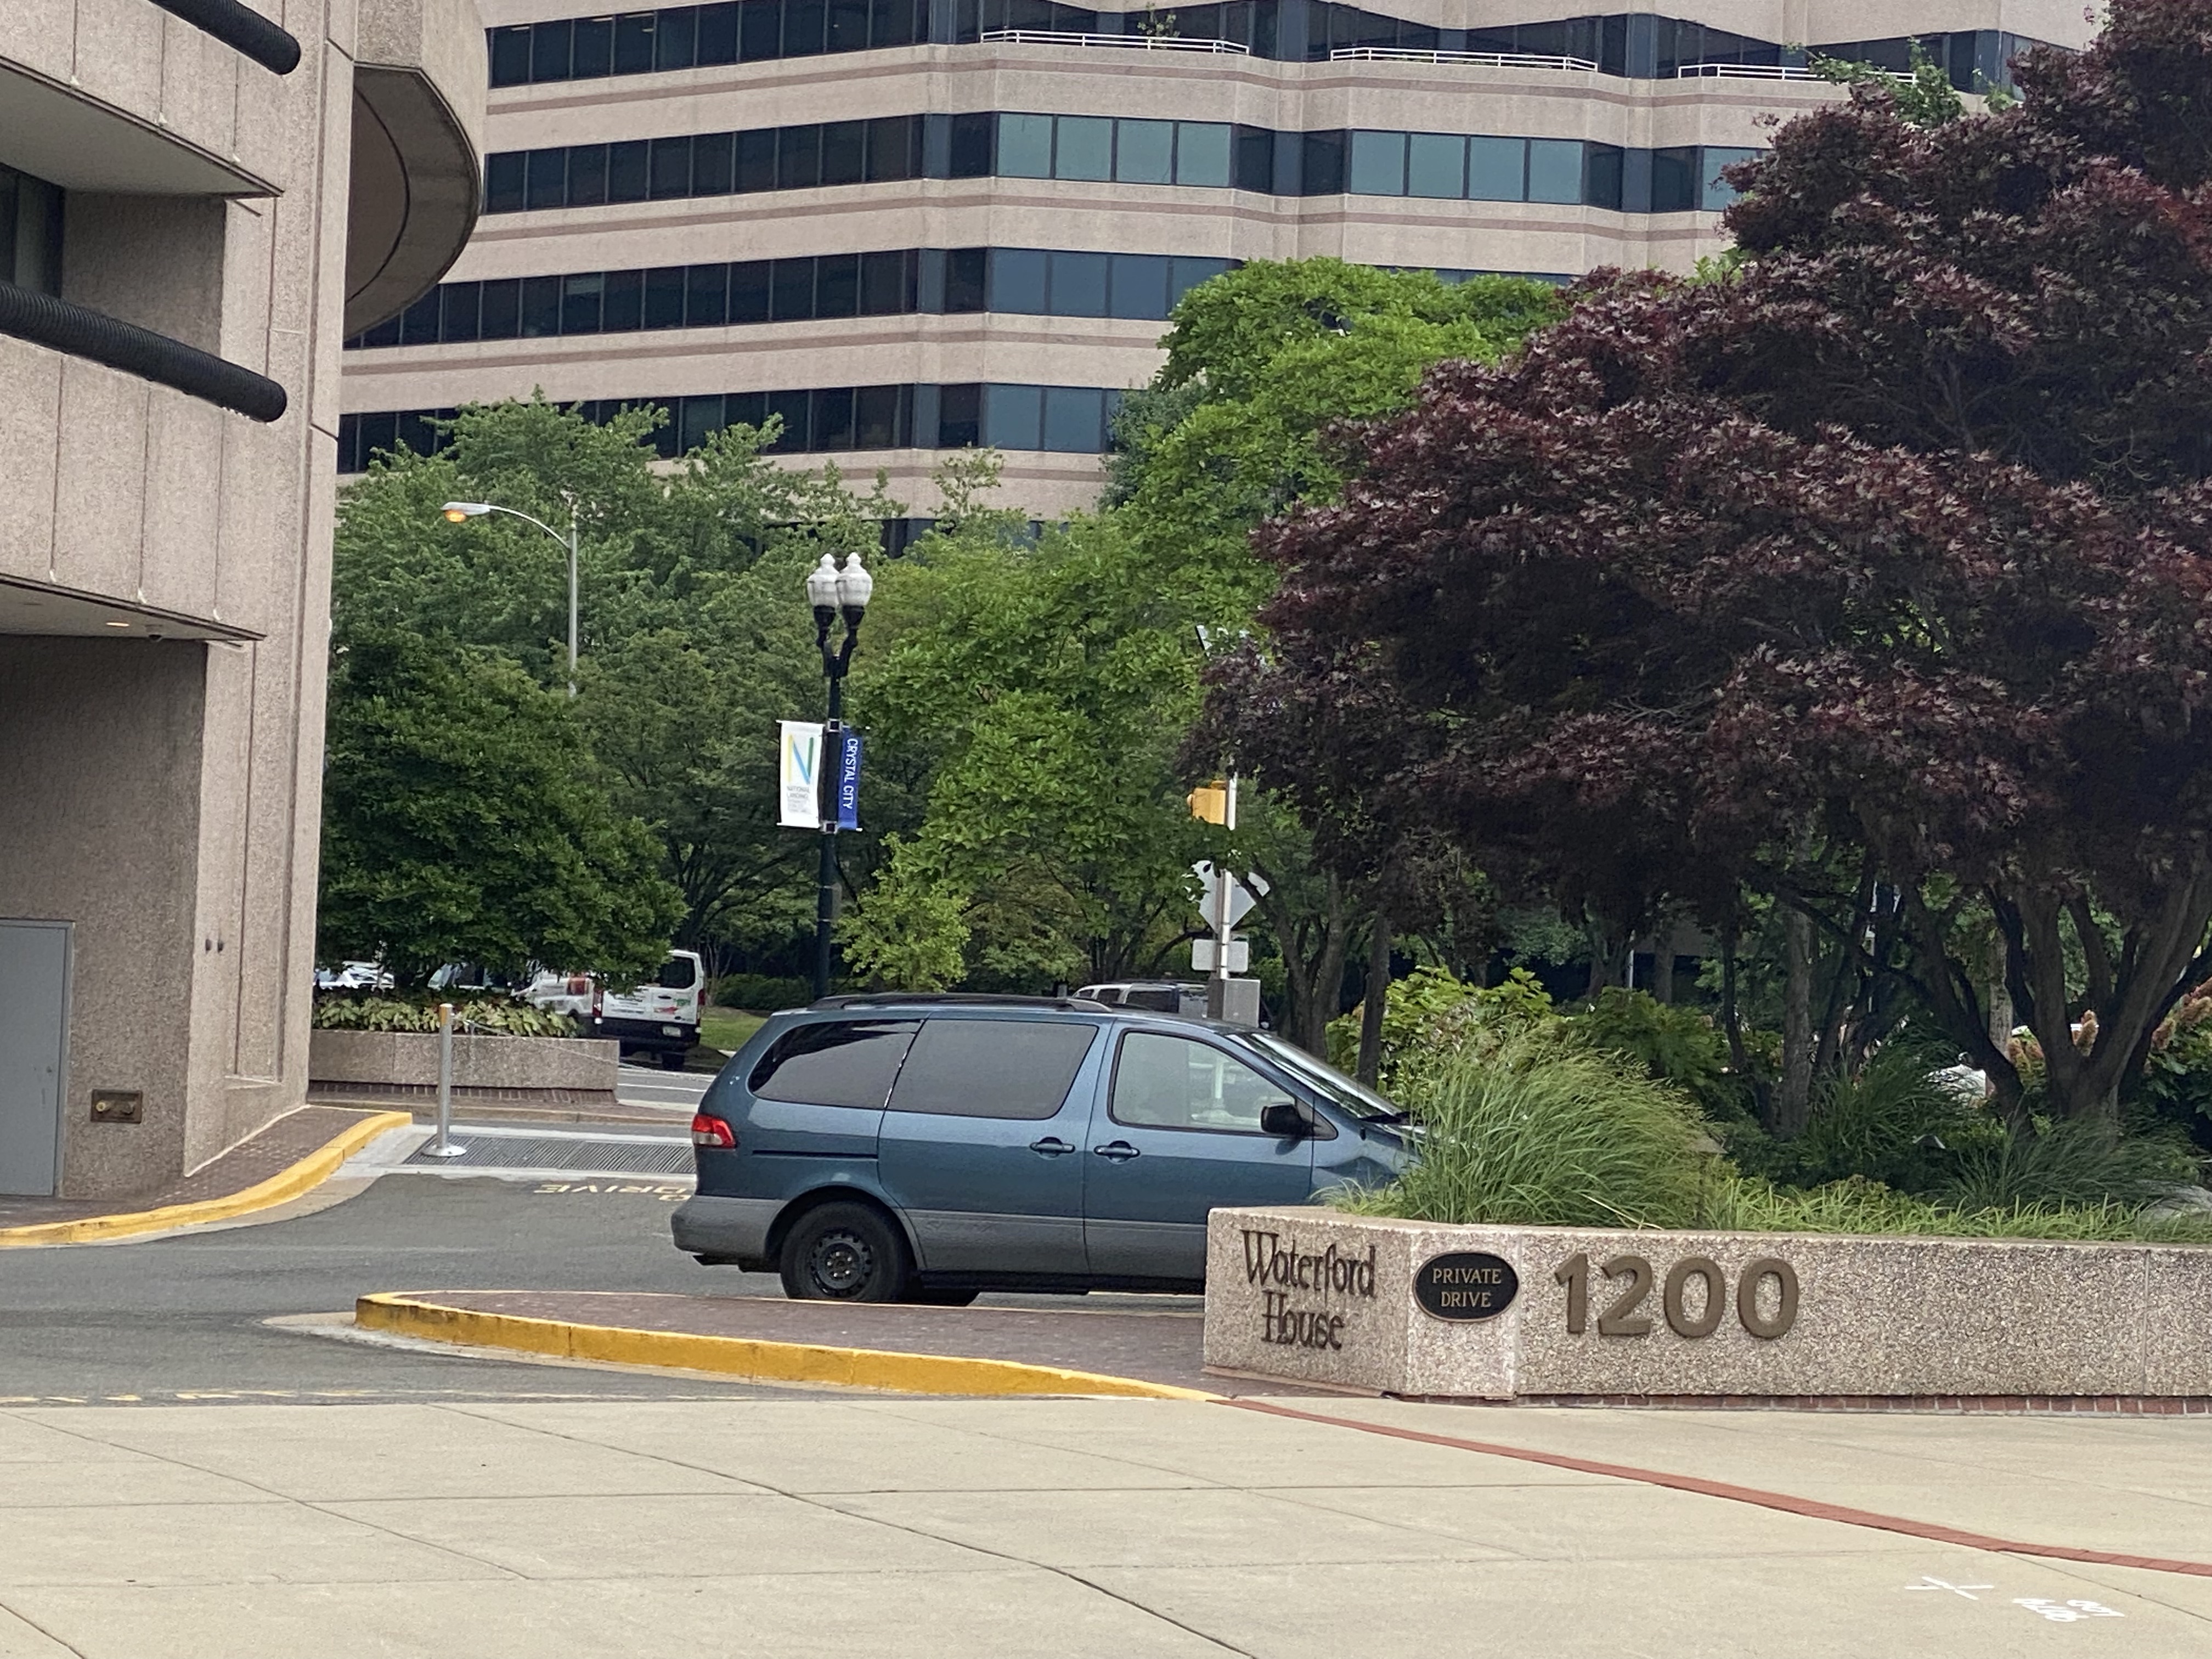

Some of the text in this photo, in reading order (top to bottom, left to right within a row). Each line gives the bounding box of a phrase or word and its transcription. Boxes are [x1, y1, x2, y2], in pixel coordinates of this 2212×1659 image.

[843, 738, 859, 810] CRYSTAL CITY
[1240, 1229, 1376, 1307] Waterford
[1432, 1268, 1502, 1285] PRIVATE
[1440, 1291, 1492, 1308] DRIVE
[1554, 1252, 1799, 1339] 1200
[1261, 1290, 1345, 1350] House
